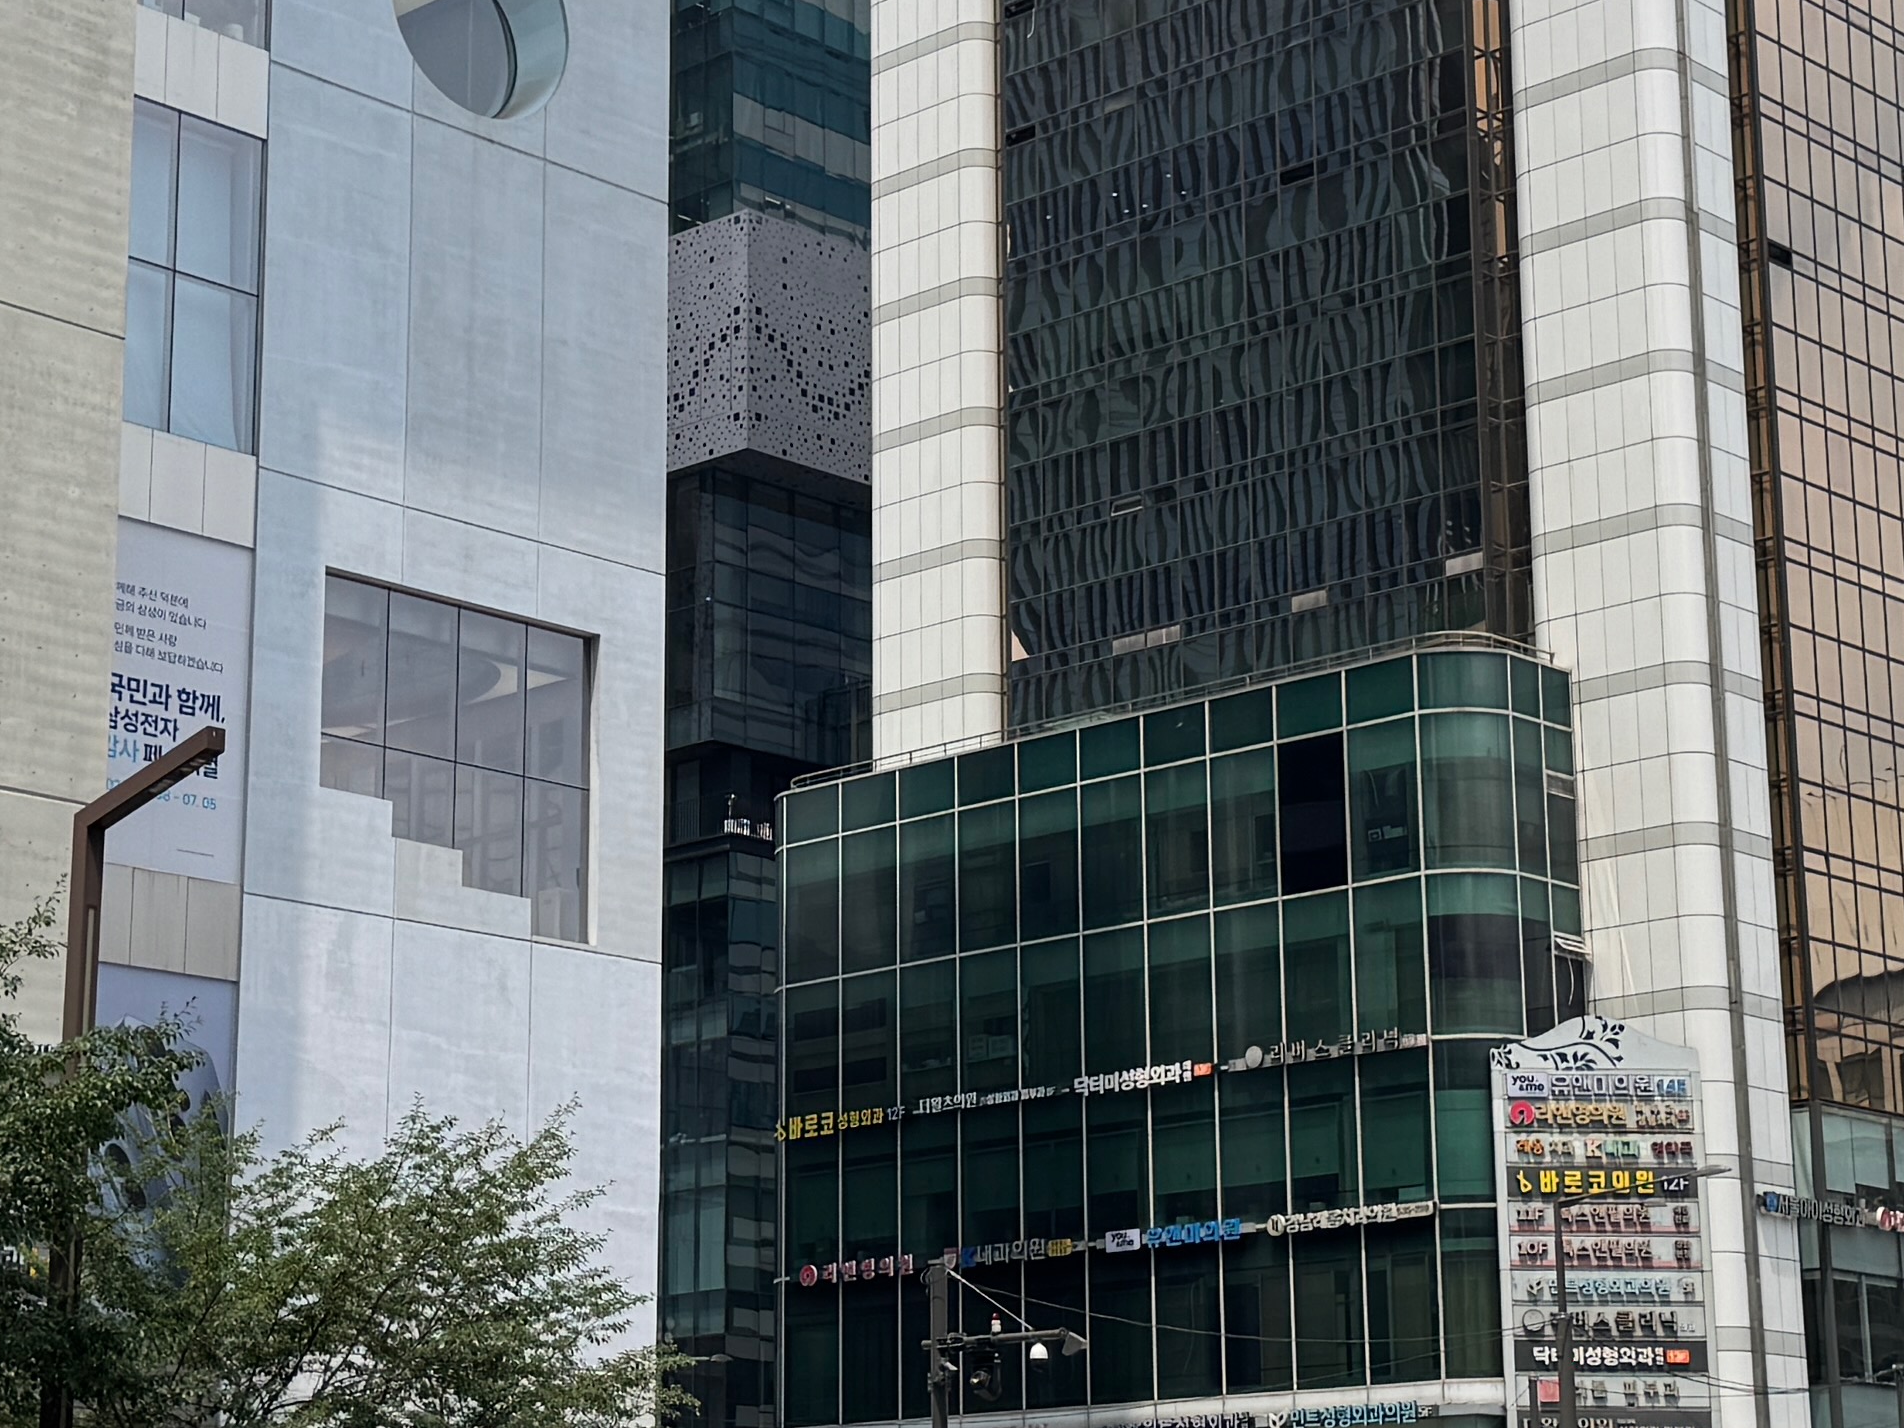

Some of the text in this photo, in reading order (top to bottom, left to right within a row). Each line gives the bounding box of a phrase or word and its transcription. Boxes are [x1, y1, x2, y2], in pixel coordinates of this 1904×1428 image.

[138, 586, 157, 601] 주신
[159, 591, 189, 608] 덕분에
[137, 603, 167, 621] 삼성이
[169, 610, 207, 630] 있습니다
[158, 631, 178, 647] 사랑
[176, 686, 226, 723] 함께,
[1551, 1073, 1655, 1096] 유앤미의원
[789, 1111, 835, 1141] 바로코
[837, 1107, 884, 1131] 성형외과
[1539, 1169, 1656, 1194] 바로코의원
